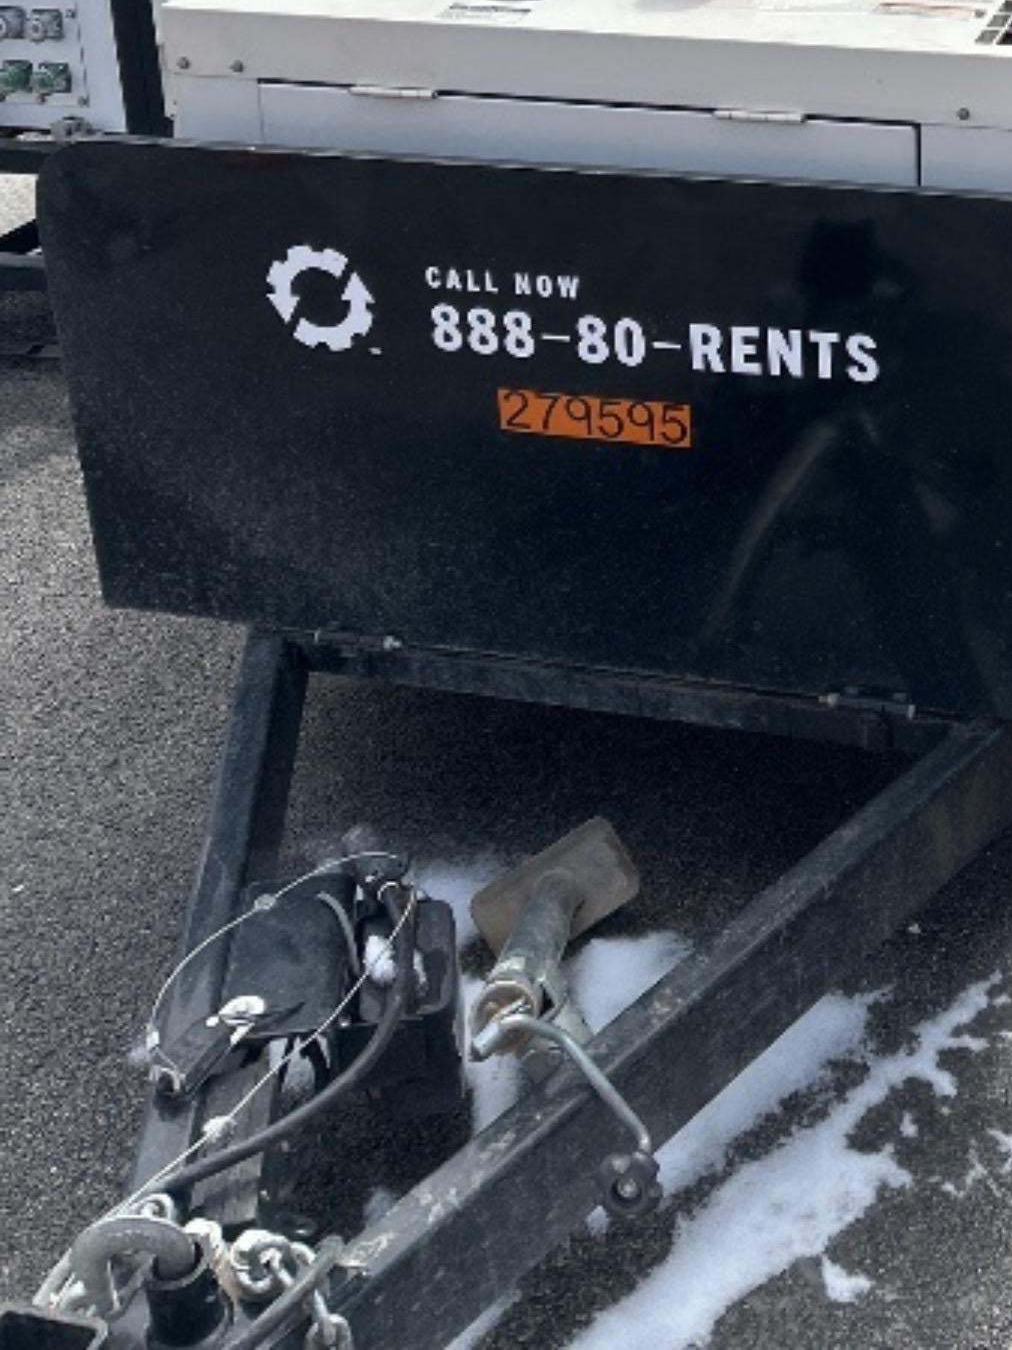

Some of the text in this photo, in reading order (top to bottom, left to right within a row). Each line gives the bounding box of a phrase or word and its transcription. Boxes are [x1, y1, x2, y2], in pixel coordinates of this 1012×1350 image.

[425, 266, 580, 300] CALL NOW
[430, 302, 880, 383] 888-80-RENTS
[503, 391, 689, 445] 279595
